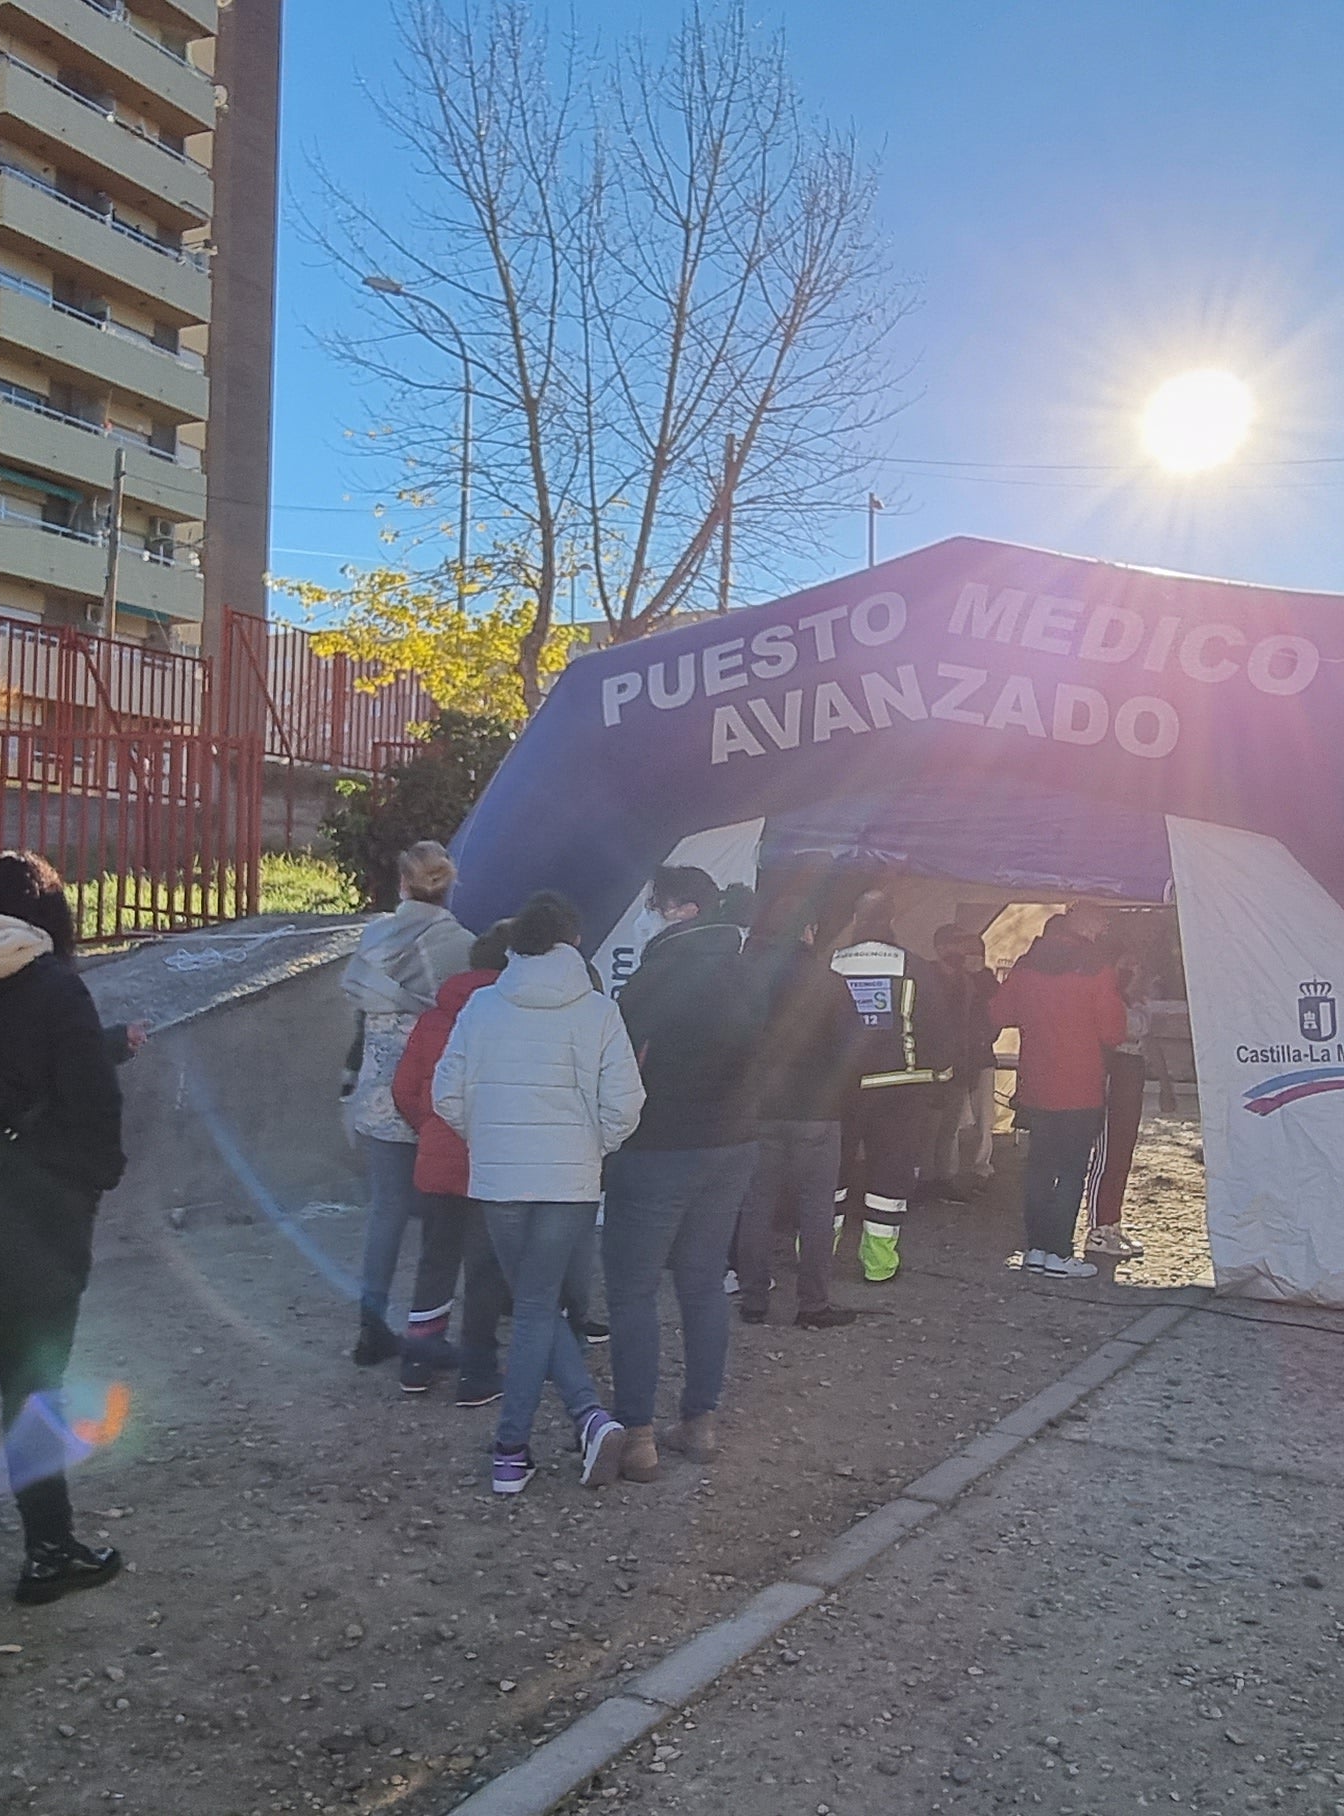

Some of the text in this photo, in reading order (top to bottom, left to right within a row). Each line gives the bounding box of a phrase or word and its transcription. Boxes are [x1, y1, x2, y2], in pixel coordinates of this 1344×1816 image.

[602, 581, 1320, 728] PUESTO MEDICO
[711, 663, 1179, 764] AVANZADO
[863, 1014, 878, 1026] 12
[1236, 1044, 1331, 1063] Castilla-La
